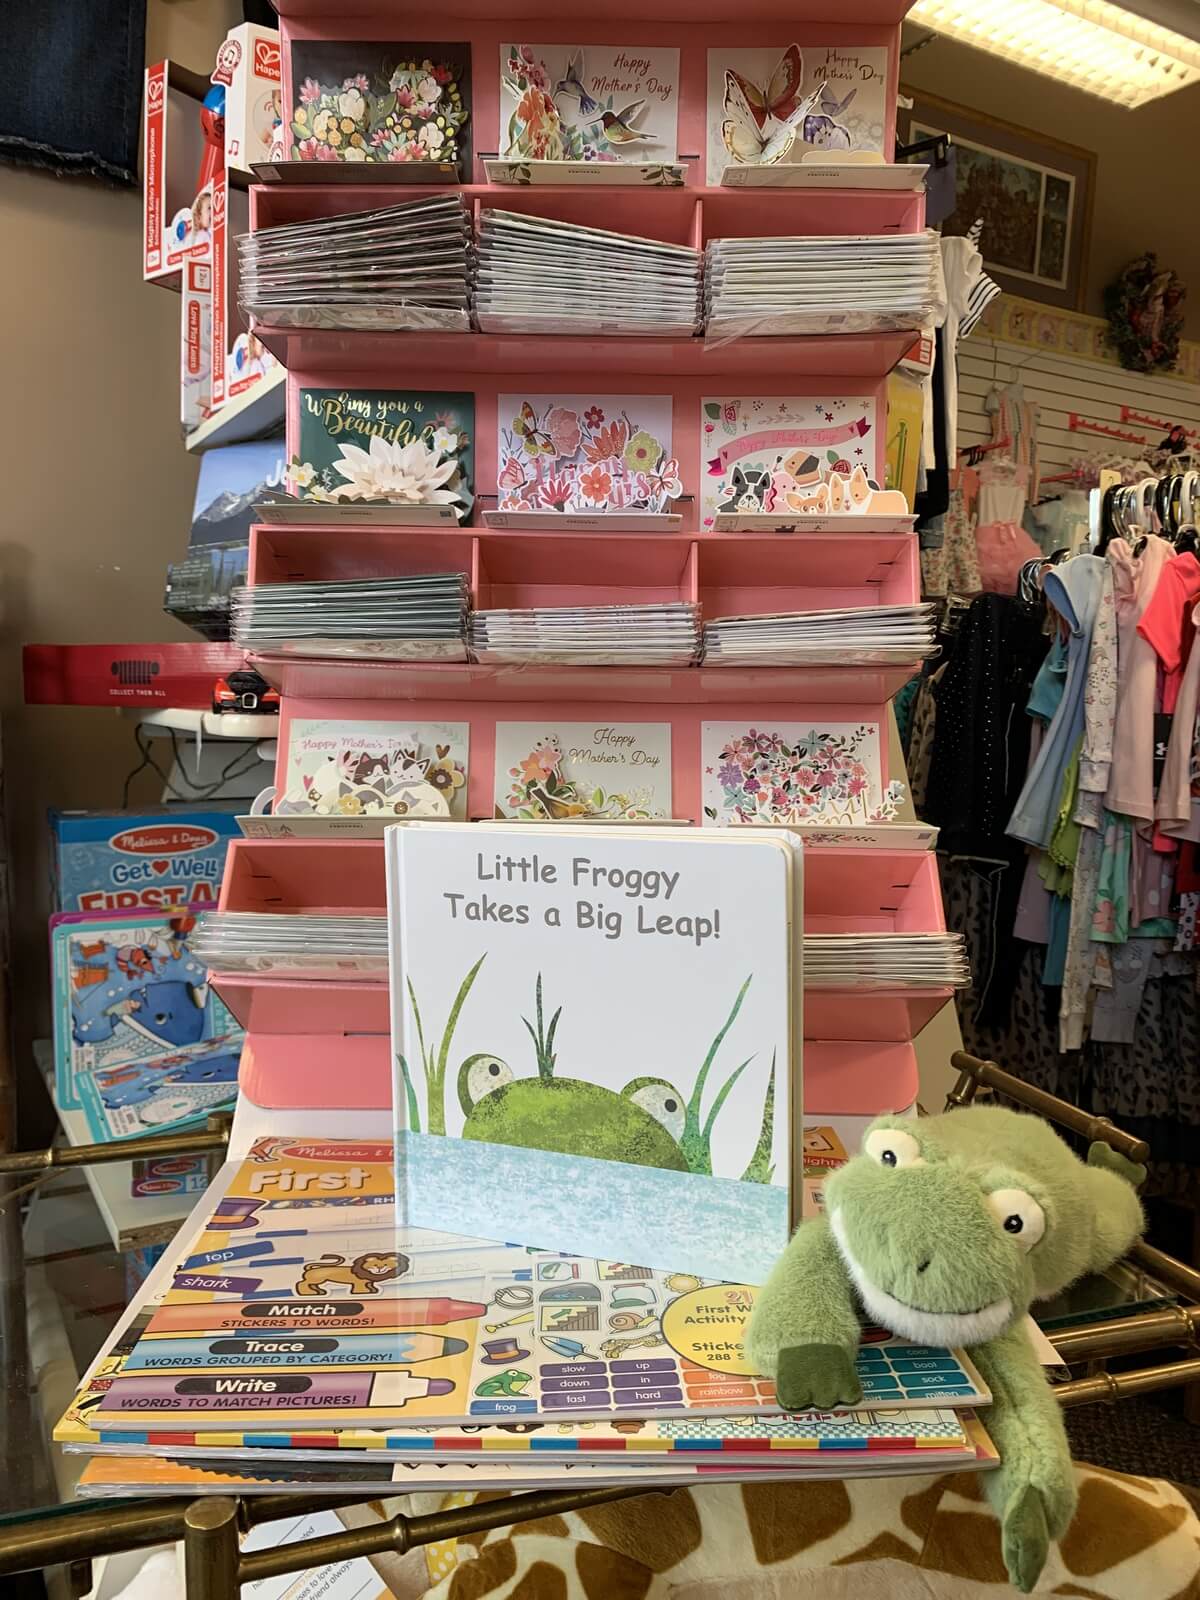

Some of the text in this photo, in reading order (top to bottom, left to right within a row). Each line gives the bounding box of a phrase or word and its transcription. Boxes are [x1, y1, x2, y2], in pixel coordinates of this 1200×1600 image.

[614, 52, 652, 76] Happy
[825, 48, 859, 68] Happy
[592, 76, 673, 101] Mother's Day
[376, 400, 410, 419] you
[414, 400, 425, 413] a
[593, 728, 638, 747] Happy
[568, 748, 661, 767] Mother's Day
[120, 834, 170, 850] Melissa
[112, 861, 153, 883] Get
[477, 852, 681, 900] Little Froggy
[443, 892, 721, 947] Takes a Big Leap!
[298, 1146, 369, 1157] Melissa
[249, 1166, 372, 1194] First
[205, 1250, 235, 1263] top
[181, 1275, 233, 1289] shark
[267, 1304, 337, 1316] Match
[695, 1304, 731, 1314] First
[220, 1318, 376, 1328] STICKERS TO WORDS!
[684, 1315, 746, 1325] Activity
[245, 1340, 305, 1353] Trace
[144, 1353, 393, 1367] WORDS GROUPED BY CATEGORY!
[706, 1353, 731, 1361] 288
[561, 1365, 587, 1373] slow
[635, 1361, 650, 1371] up
[215, 1378, 277, 1393] Write
[559, 1380, 591, 1388] down
[640, 1376, 650, 1384] in
[921, 1375, 947, 1383] sock
[120, 1394, 358, 1408] WORDS TO MATCH PICTURES!
[566, 1394, 587, 1403] fast
[635, 1390, 661, 1400] hard
[495, 1403, 517, 1413] frog
[317, 1565, 333, 1580] love
